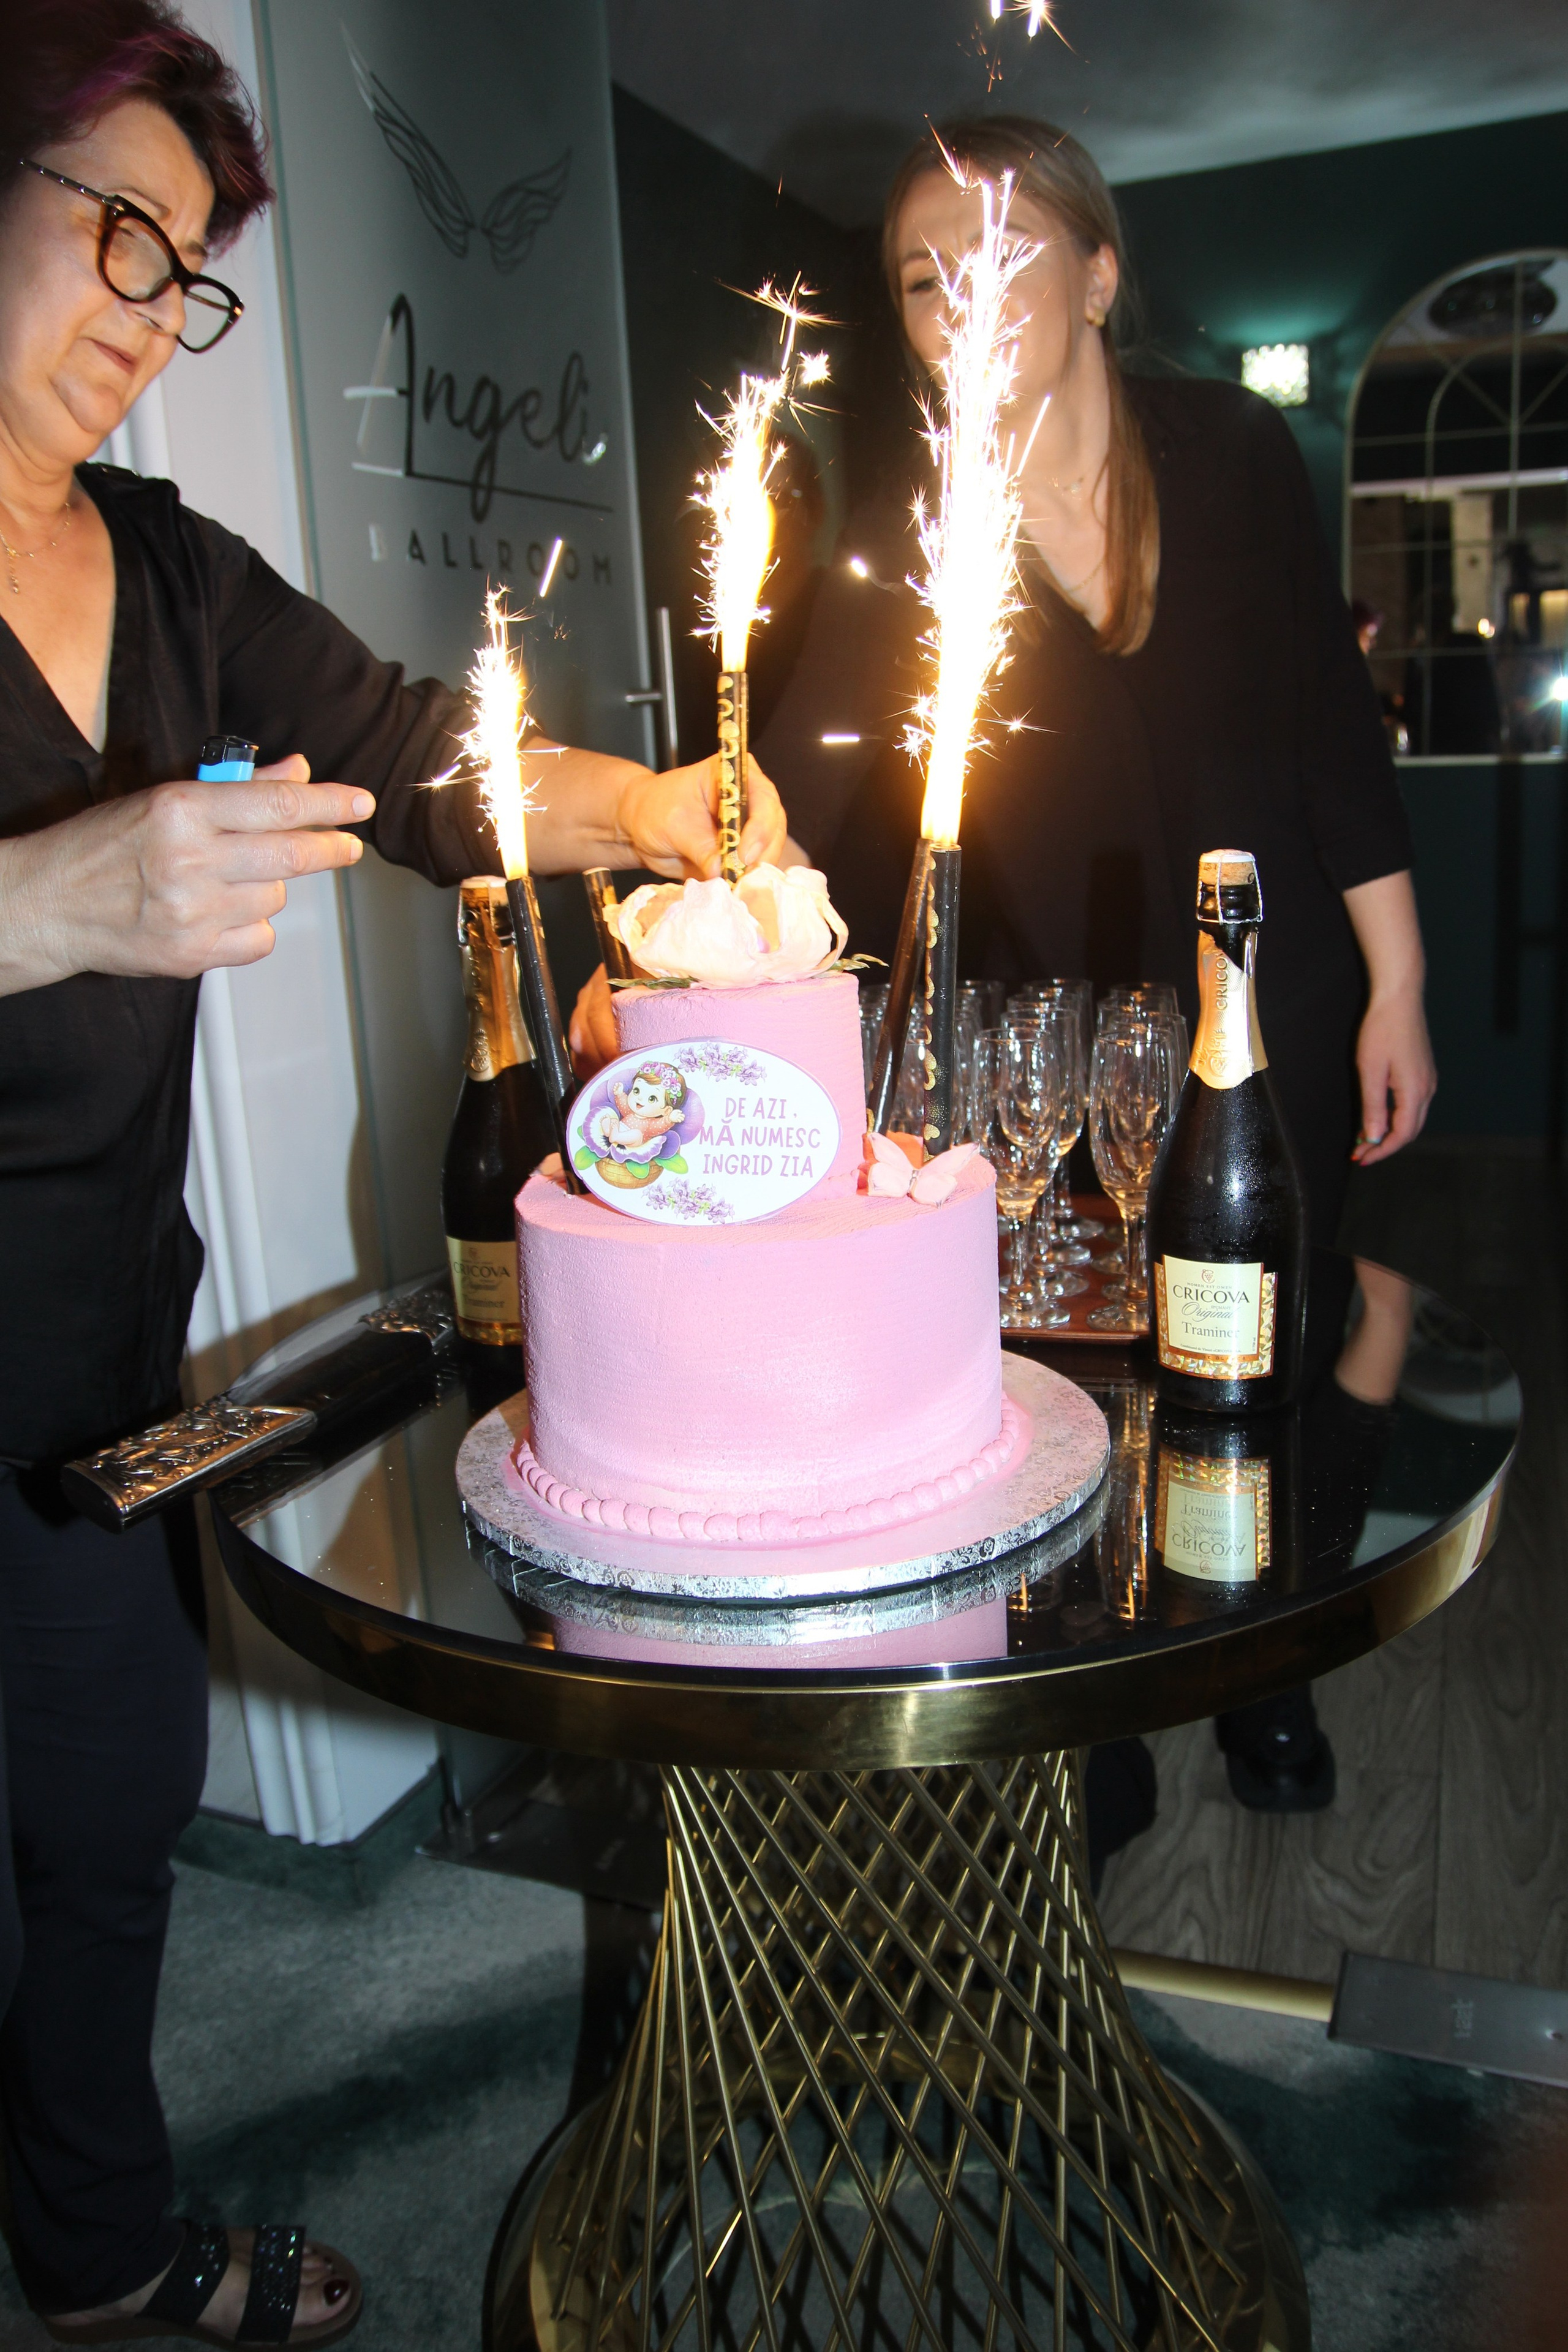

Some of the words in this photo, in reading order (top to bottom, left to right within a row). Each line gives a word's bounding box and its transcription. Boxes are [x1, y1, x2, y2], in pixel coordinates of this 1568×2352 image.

[725, 1097, 746, 1118] DE
[699, 1118, 735, 1146] MĂ
[741, 1126, 821, 1148] NUMESC
[703, 1154, 772, 1175] INGRID
[780, 1156, 813, 1178] ZIA
[454, 1262, 510, 1278] CRICOVA
[1173, 1284, 1250, 1303] CRICOVA
